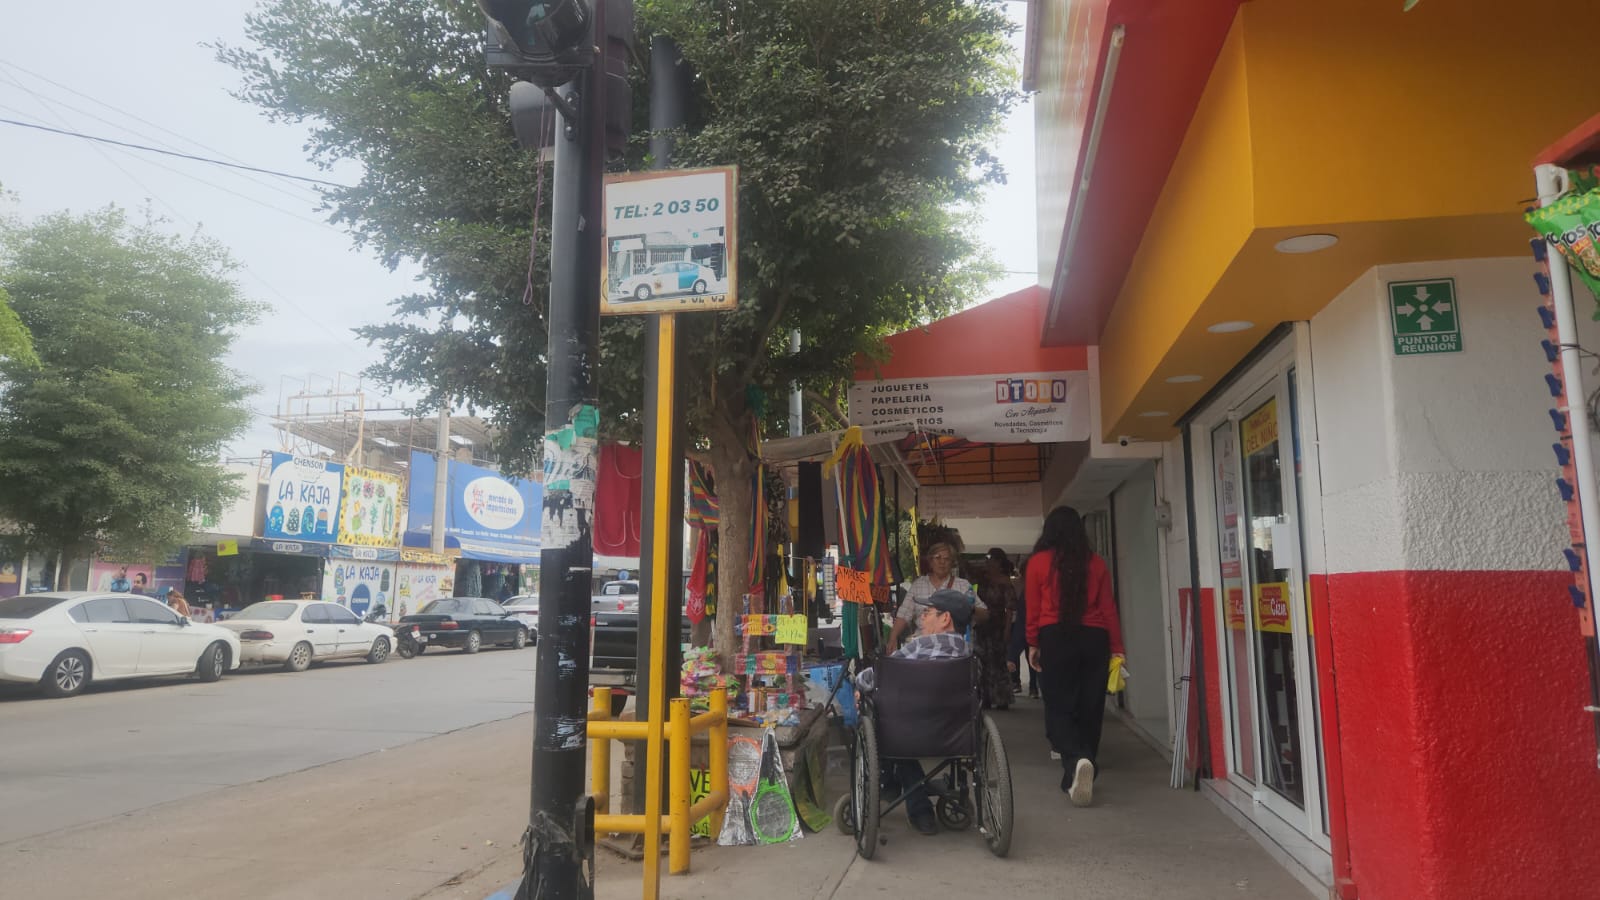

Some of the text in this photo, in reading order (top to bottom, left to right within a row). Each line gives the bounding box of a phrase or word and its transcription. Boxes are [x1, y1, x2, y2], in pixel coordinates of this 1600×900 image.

[613, 197, 720, 220] TEL: 2 03 50
[1397, 334, 1457, 345] PUNTO DE
[1401, 342, 1456, 353] REUNION
[871, 382, 929, 393] JUGUETES
[872, 394, 932, 405] PAPELERÍA
[871, 405, 944, 416] COSMÉTICOS
[873, 417, 944, 426] ARIOS
[293, 458, 324, 470] CHENSON
[278, 480, 331, 505] LA KAJA
[345, 565, 380, 581] LA KAJA
